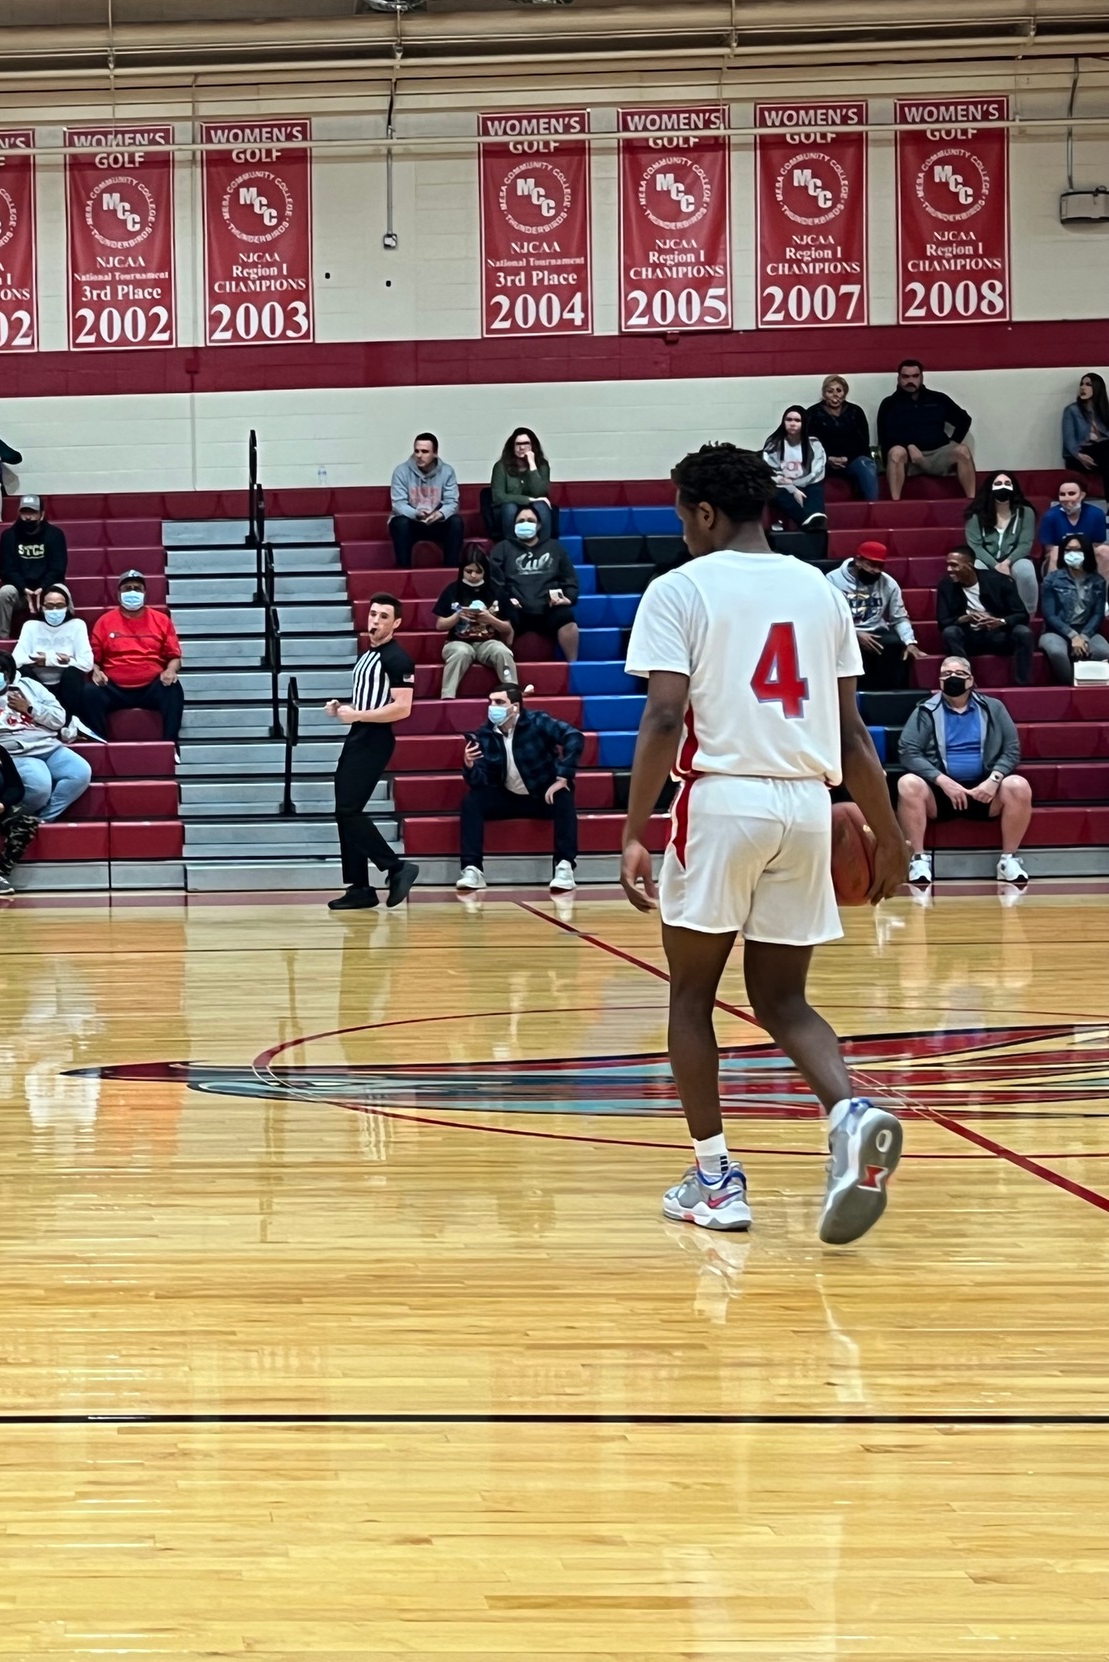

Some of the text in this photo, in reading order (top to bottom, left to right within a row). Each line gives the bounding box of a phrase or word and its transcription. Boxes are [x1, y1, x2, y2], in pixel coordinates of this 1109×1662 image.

[764, 108, 858, 126] WOMEN'S
[904, 104, 999, 123] WOMEN'S
[487, 117, 580, 136] WOMEN'S
[627, 113, 720, 131] WOMEN'S
[74, 132, 166, 146] WOMEN'S
[210, 126, 303, 144] WOMEN'S
[786, 131, 836, 144] GOLF
[926, 128, 977, 140] GOLF
[509, 141, 560, 154] GOLF
[648, 136, 699, 149] GOLF
[95, 153, 144, 168] GOLF
[232, 149, 282, 163] GOLF
[643, 157, 692, 180] COMMUNITY
[692, 164, 711, 202] COLLEGE
[780, 152, 830, 174] COMMUNITY
[830, 160, 848, 199] COLLEGE
[922, 148, 971, 171] COMMUNITY
[971, 156, 990, 195] COLLEGE
[504, 162, 552, 184] COMMUNITY
[552, 168, 571, 208] COLLEGE
[656, 174, 694, 212] MCC
[794, 169, 832, 208] MCC
[934, 166, 973, 204] MCC
[90, 176, 137, 198] COMMUNITY
[138, 184, 156, 222] COLLEGE
[226, 171, 275, 193] COMMUNITY
[274, 178, 292, 216] COLLEGE
[516, 178, 556, 216] MCC
[0, 188, 16, 227] COLLEGE
[102, 193, 140, 232] MCC
[239, 188, 278, 226] MCC
[792, 235, 834, 245] NJCAA
[934, 231, 976, 241] NJCAA
[511, 242, 561, 254] NJCAA
[655, 240, 697, 249] NJCAA
[926, 243, 983, 258] Region I
[96, 256, 145, 268] NJCAA
[239, 253, 280, 262] NJCAA
[649, 250, 705, 265] Region I
[786, 246, 841, 262] Region I
[488, 257, 584, 268] National Tournament
[766, 262, 860, 276] CHAMPIONS
[908, 258, 1002, 272] CHAMPIONS
[7, 274, 11, 285] I
[74, 271, 168, 282] National Tournament
[233, 264, 287, 280] Region I
[495, 271, 577, 287] 3rd Place
[630, 265, 724, 280] CHAMPIONS
[82, 286, 161, 301] 3rd Place
[214, 279, 306, 293] CHAMPIONS
[763, 284, 861, 321] 2007
[904, 280, 1004, 317] 2008
[490, 292, 585, 329] 2004
[627, 288, 726, 326] 2005
[75, 306, 170, 343] 2002
[211, 301, 308, 340] 2003
[750, 622, 809, 719] 4
